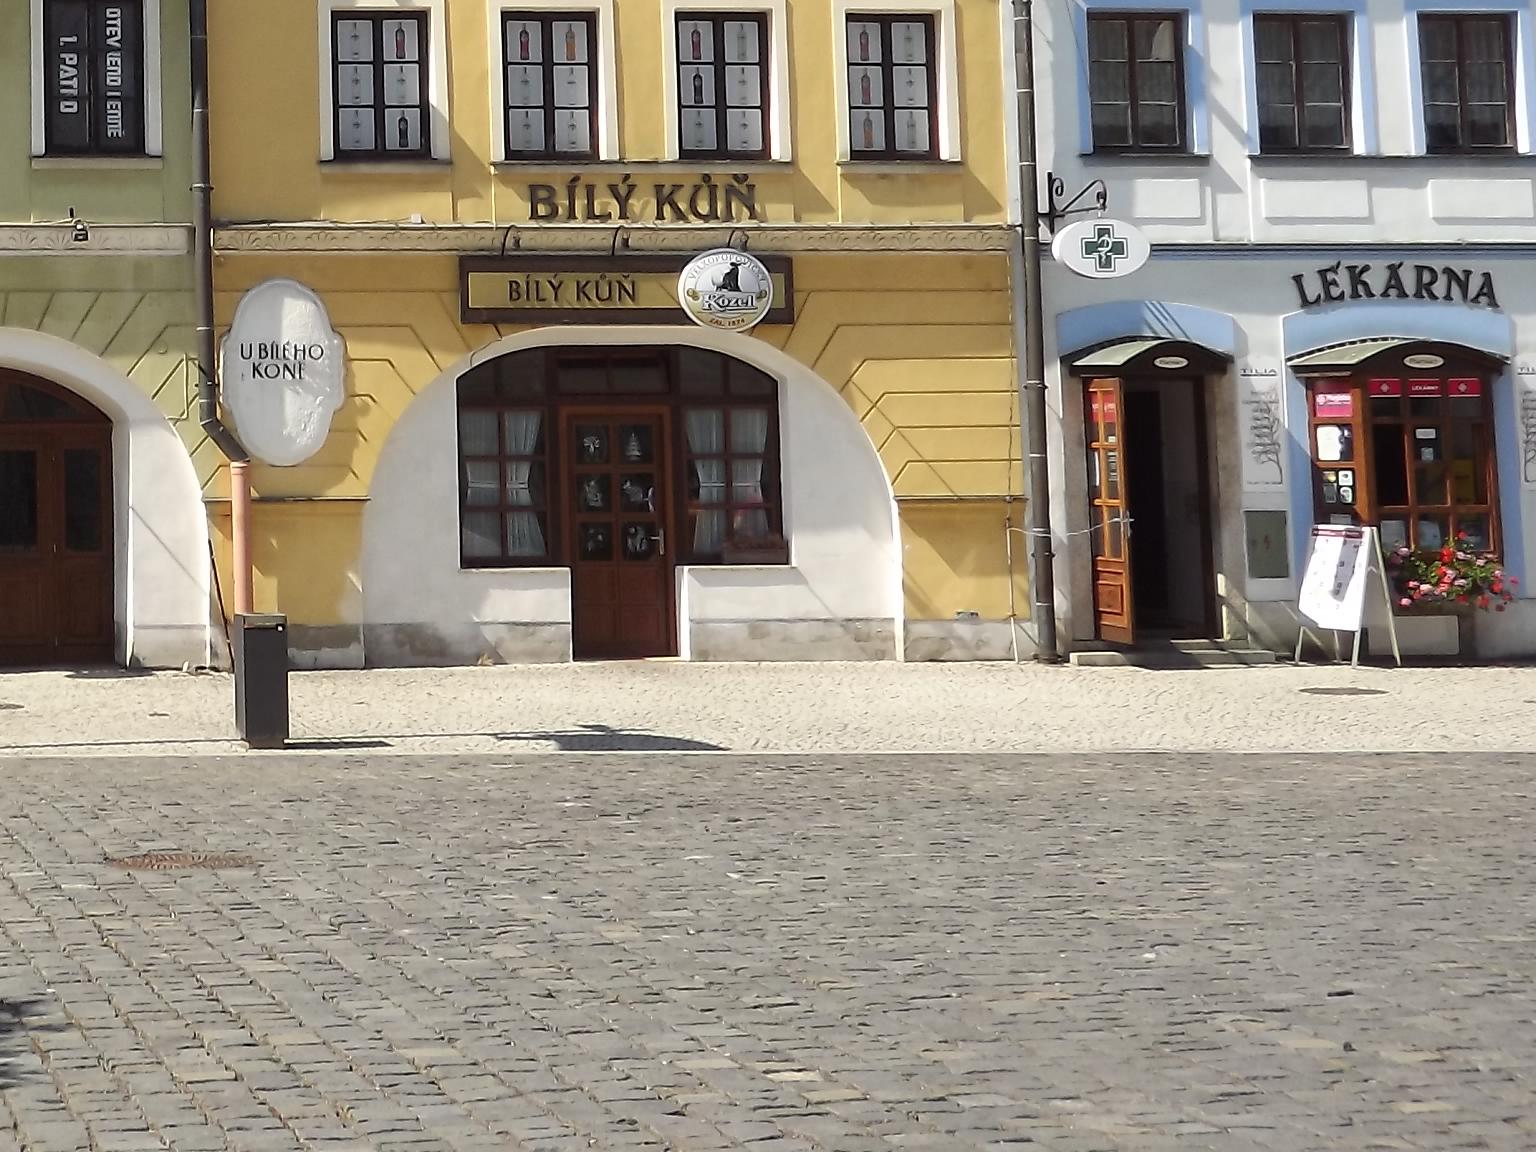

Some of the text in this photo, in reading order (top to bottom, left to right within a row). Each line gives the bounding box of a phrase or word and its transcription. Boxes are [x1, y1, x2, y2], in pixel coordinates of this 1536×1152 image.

[528, 173, 756, 221] BÍLÝ KŮŇ
[508, 273, 636, 303] BÍLÝ KŮŇ
[1290, 260, 1501, 309] LÉKÁRNA
[703, 293, 757, 312] Kozel
[240, 342, 253, 361] U
